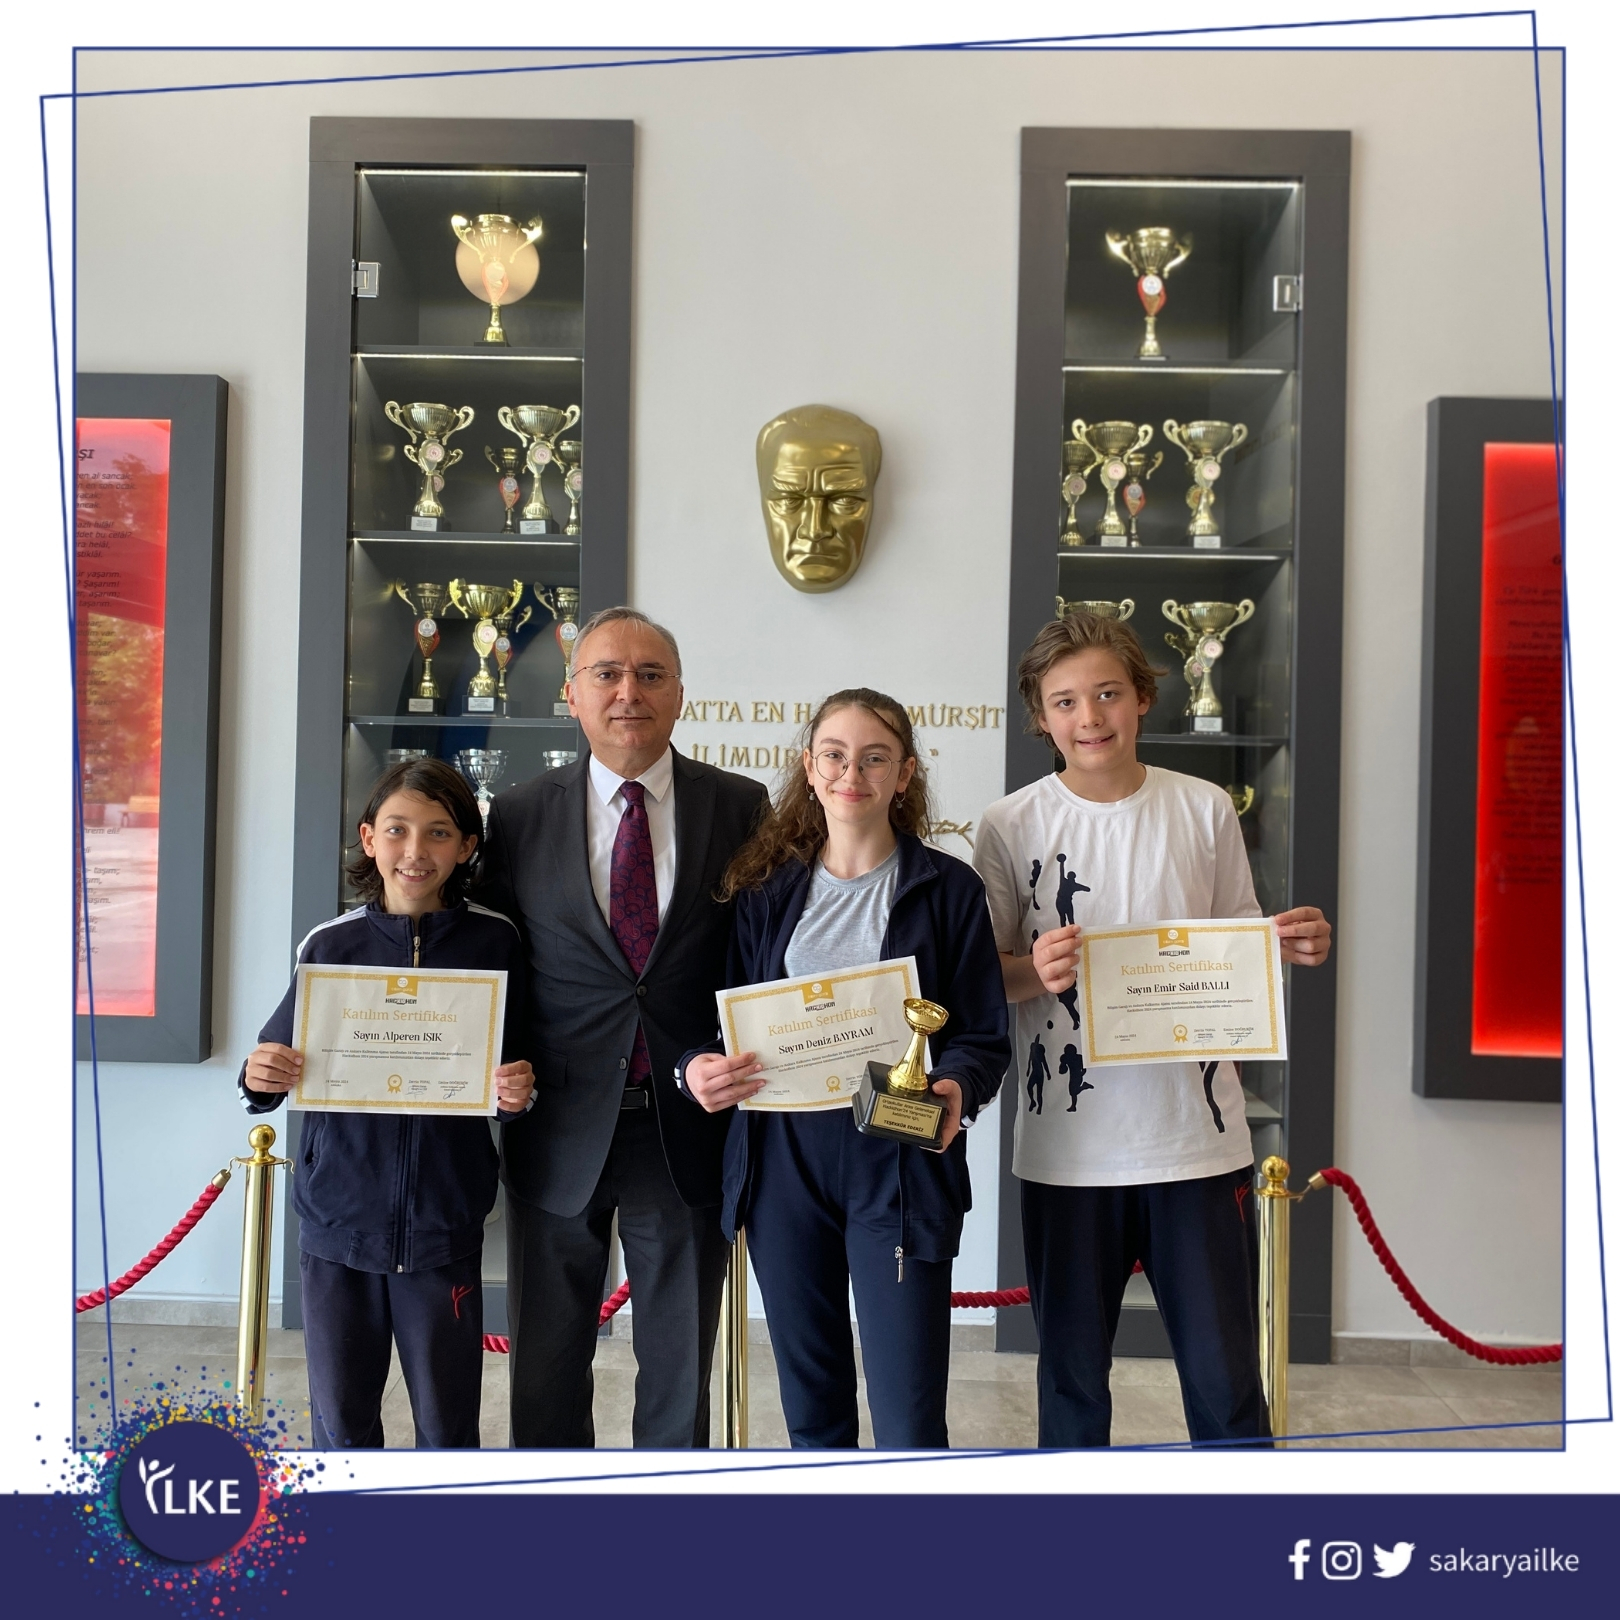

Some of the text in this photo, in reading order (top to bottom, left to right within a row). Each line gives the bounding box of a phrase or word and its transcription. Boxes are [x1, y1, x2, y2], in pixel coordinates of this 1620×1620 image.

[751, 701, 785, 722] EN
[905, 703, 1005, 731] MÜRŞİT
[1120, 959, 1234, 976] Katılım Sertifikası
[1126, 981, 1230, 996] Sayın Emir Said BALLI
[342, 1008, 458, 1023] Katılım Sertifikası
[767, 1006, 878, 1037] Katılım Sertifikası
[353, 1030, 380, 1042] Sayın
[382, 1030, 421, 1043] Alperen
[778, 1026, 875, 1055] Sayın Deniz BAYRAM
